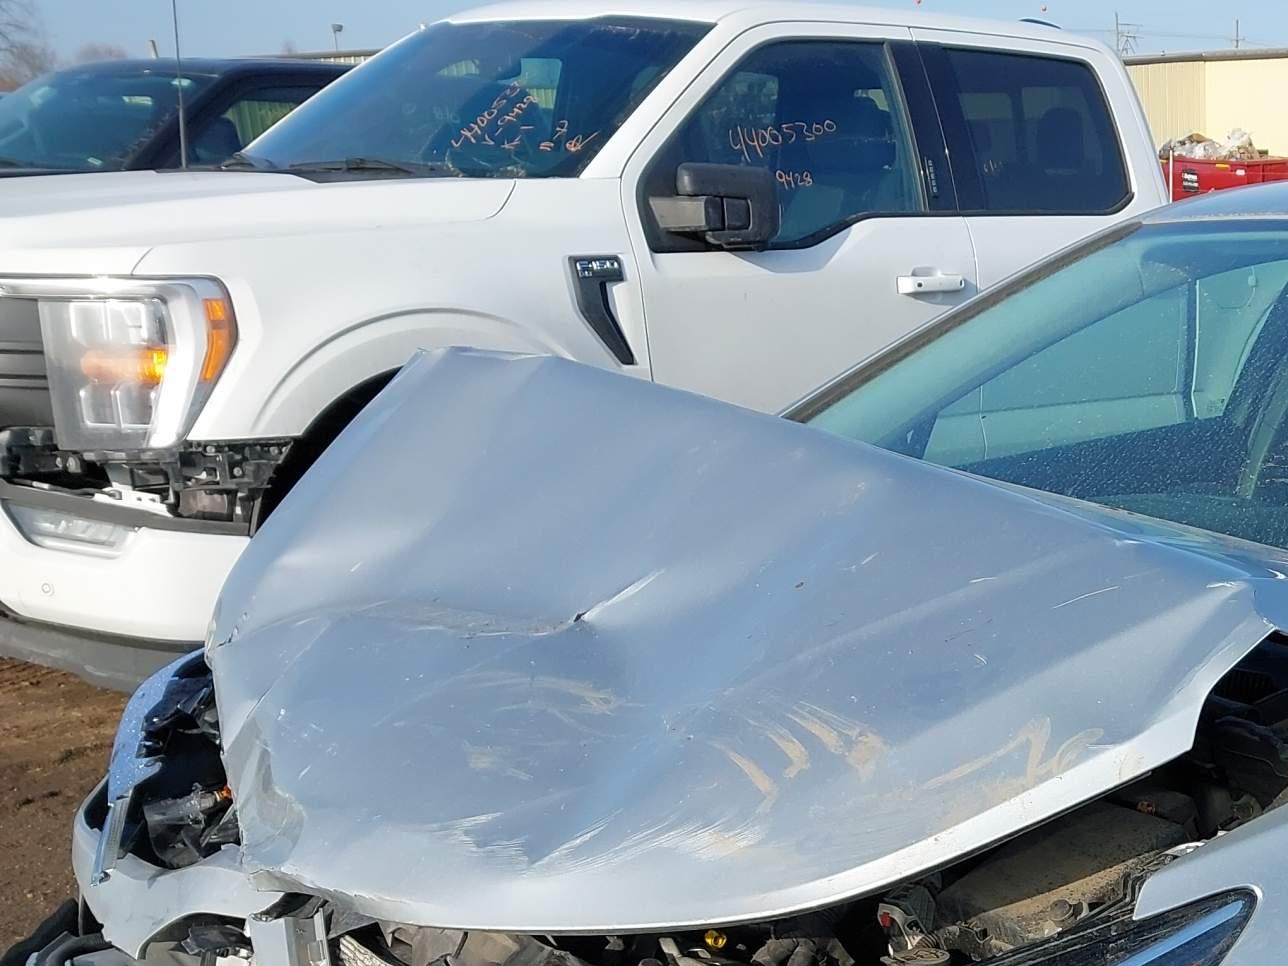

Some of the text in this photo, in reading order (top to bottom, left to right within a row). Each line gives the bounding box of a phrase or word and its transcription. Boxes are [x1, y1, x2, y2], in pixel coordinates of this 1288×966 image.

[729, 120, 837, 162] 44005300
[776, 170, 813, 190] 9428
[576, 260, 619, 270] F-150
